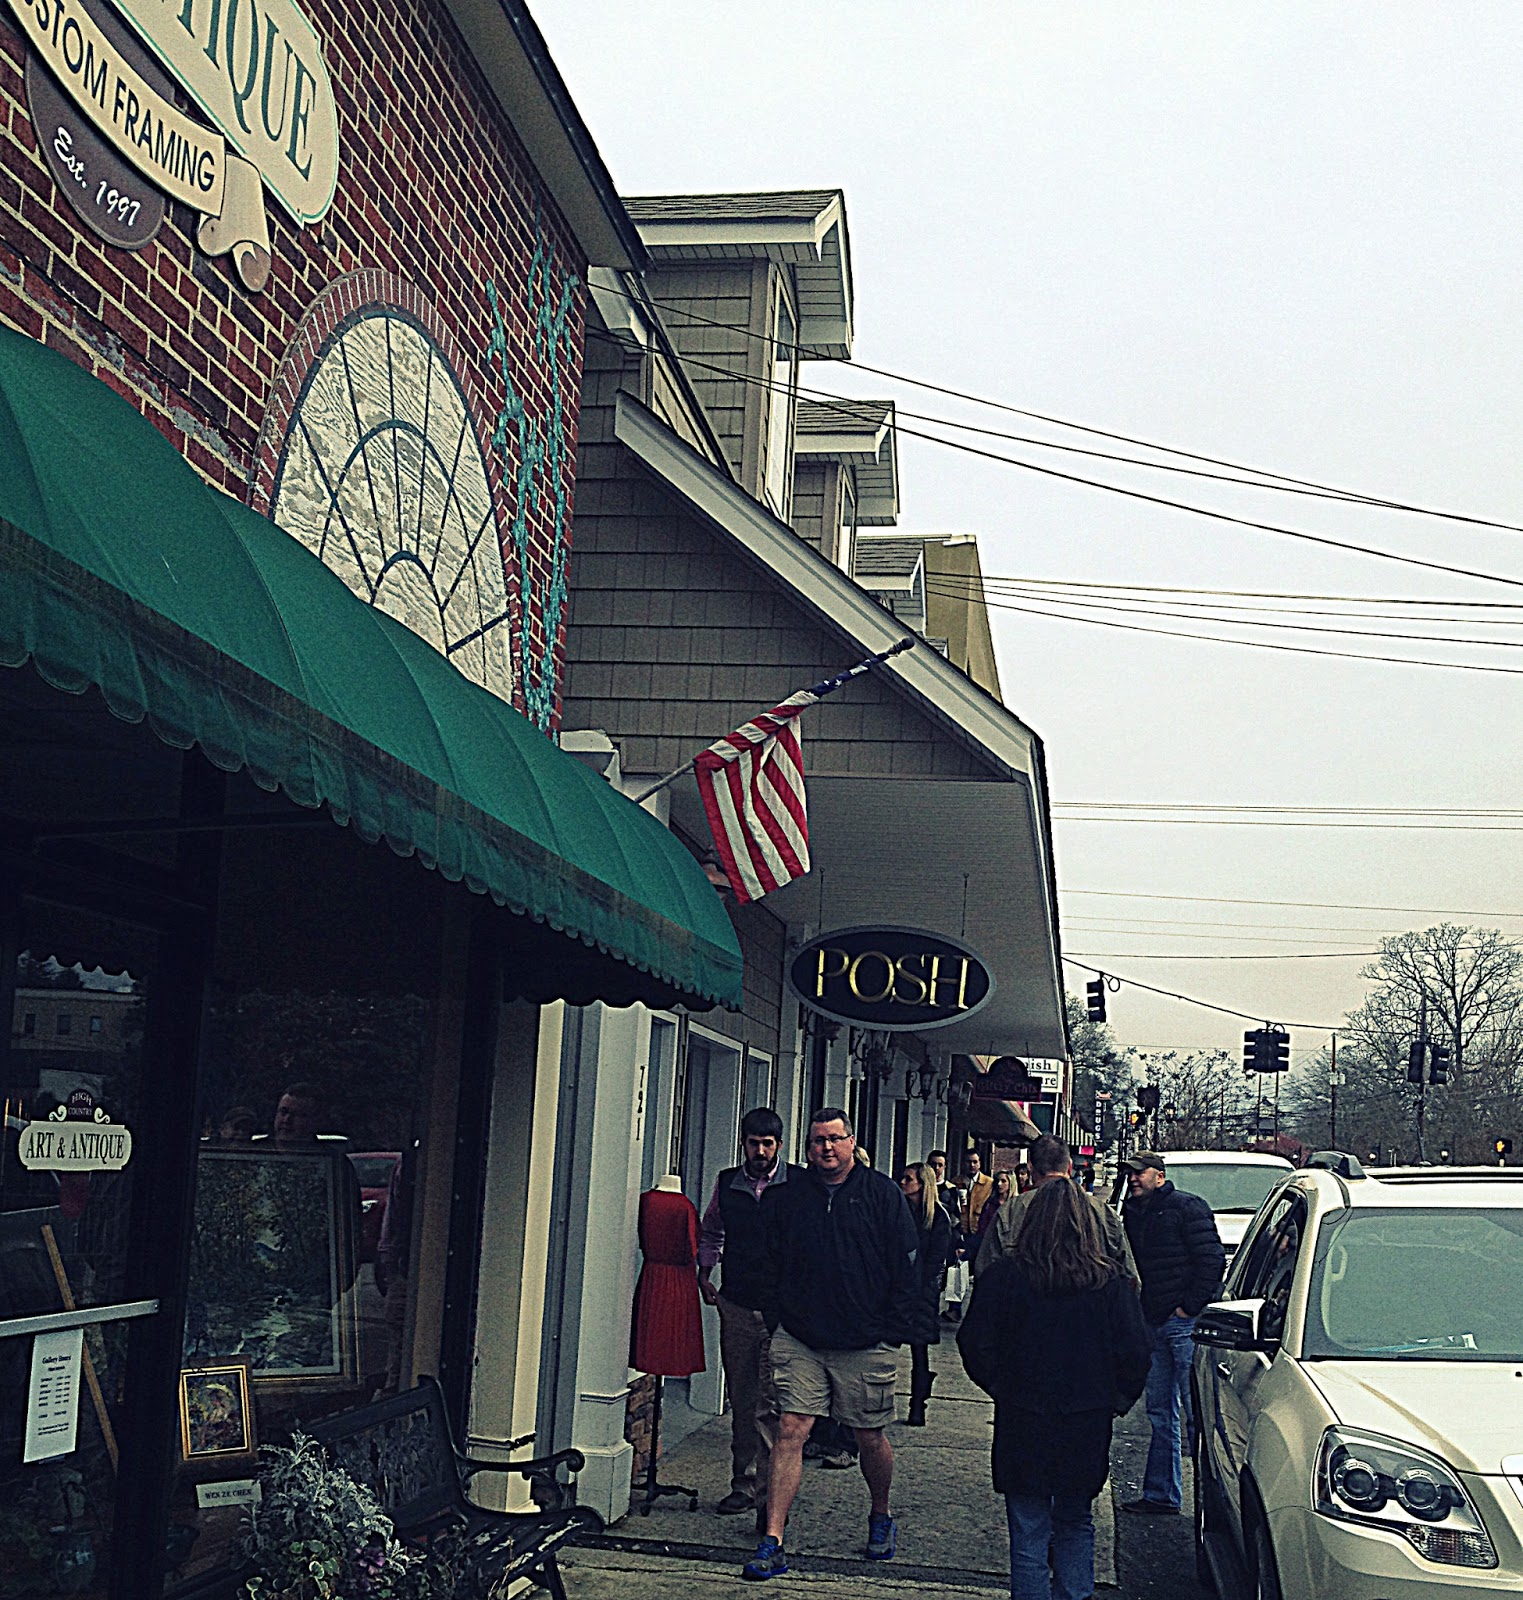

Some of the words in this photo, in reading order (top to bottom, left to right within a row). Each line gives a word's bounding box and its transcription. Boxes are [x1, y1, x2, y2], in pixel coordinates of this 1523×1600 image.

[25, 0, 108, 109] STOM
[113, 76, 216, 191] FRAMING
[53, 126, 87, 189] Est.
[95, 180, 141, 227] 1997
[808, 948, 974, 1010] POSH
[68, 1107, 93, 1116] COUNTRY
[71, 1092, 92, 1106] HIGH
[26, 1132, 54, 1158] ART
[57, 1137, 65, 1158] &
[69, 1133, 124, 1164] ANTIQUE
